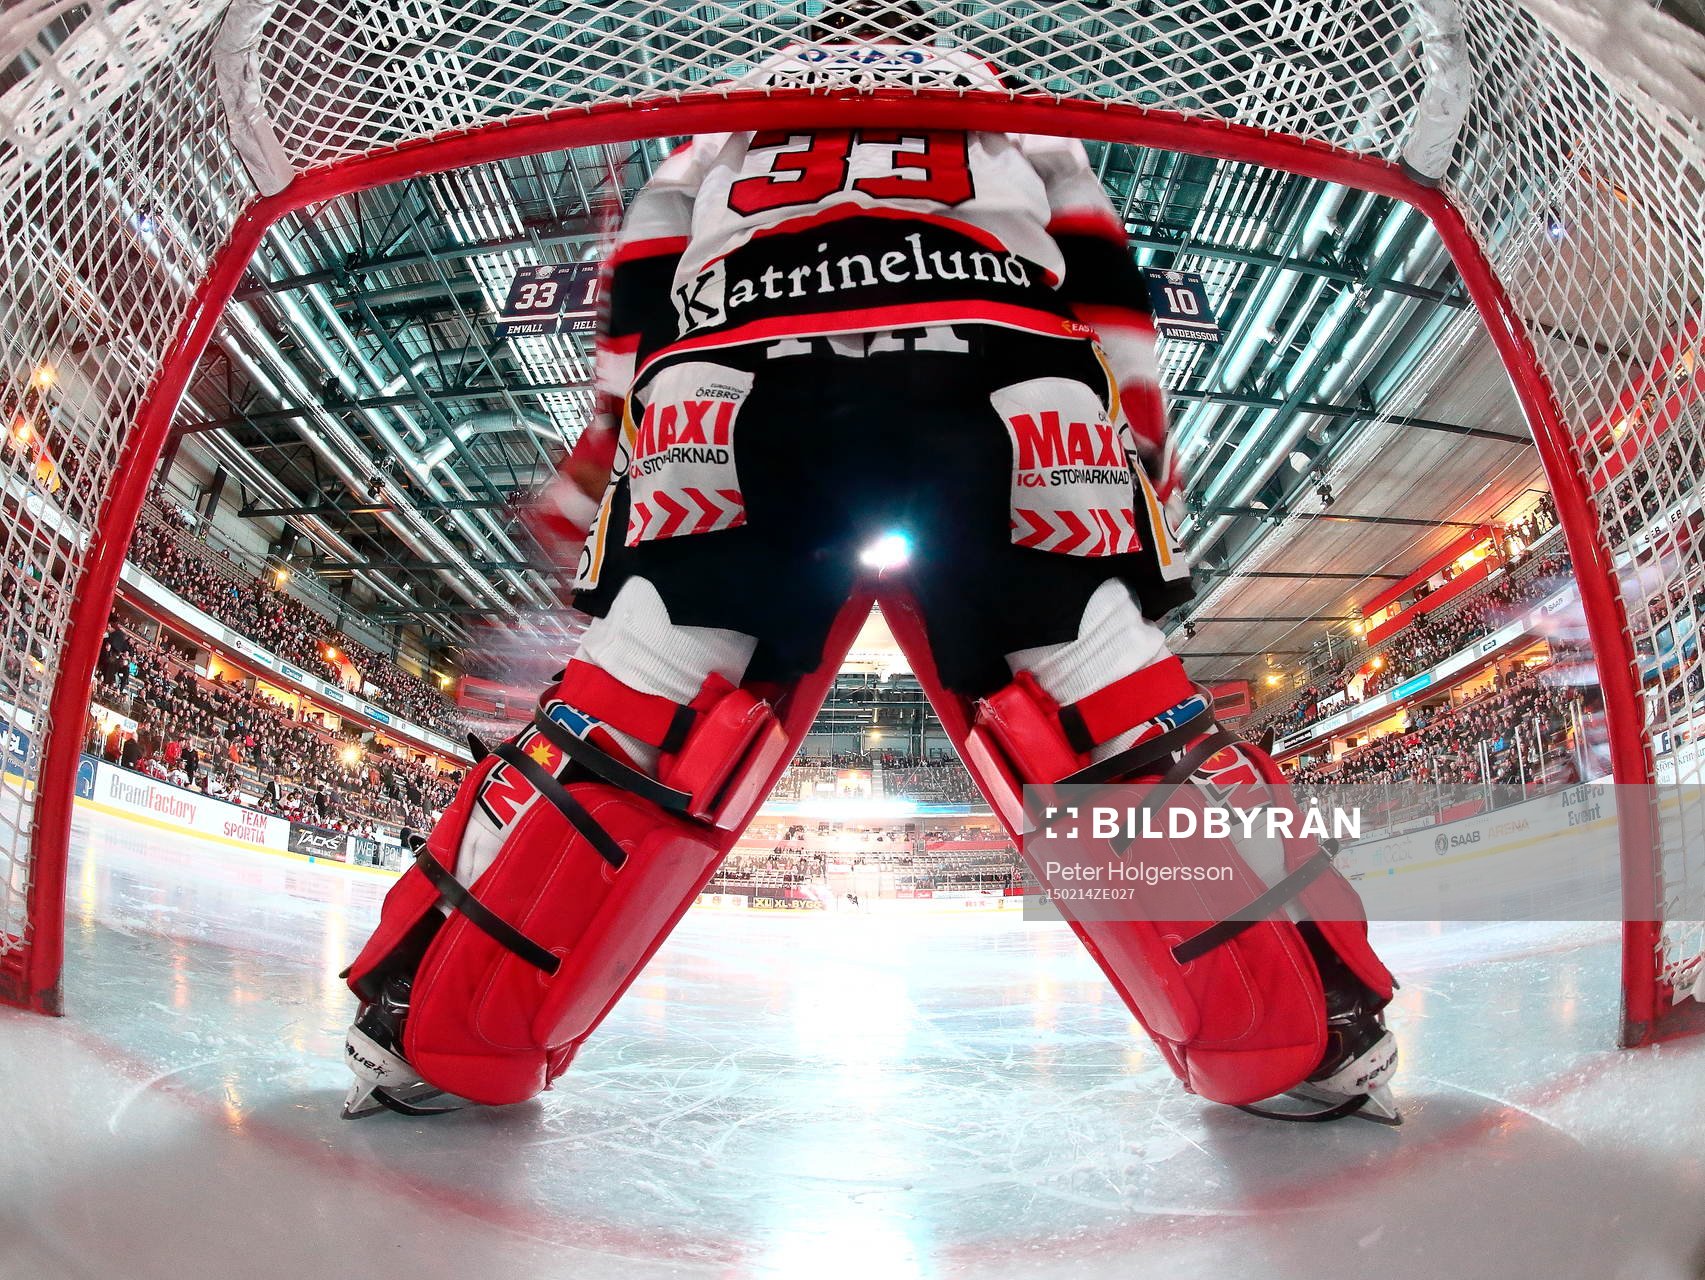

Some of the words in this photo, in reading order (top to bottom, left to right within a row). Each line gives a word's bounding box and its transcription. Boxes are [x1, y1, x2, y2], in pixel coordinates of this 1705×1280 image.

[728, 129, 976, 217] 33
[514, 281, 558, 310] 33
[676, 233, 1031, 334] Katrinelund
[1163, 287, 1199, 315] 10
[507, 323, 544, 334] EMVALL
[1166, 328, 1219, 342] ANDERSSON
[695, 387, 740, 400] ÖREBRO
[636, 400, 736, 460] MAXI
[630, 464, 644, 479] CA
[1017, 473, 1046, 488] ICA
[109, 773, 197, 825] BrandFactory
[1561, 783, 1605, 807] ActiPro
[241, 810, 268, 829] TEAM
[1568, 803, 1601, 827] Event
[223, 822, 265, 845] SPORTIA
[297, 828, 340, 850] TACKS
[1450, 830, 1481, 848] SAAB
[1487, 818, 1529, 840] ARENA
